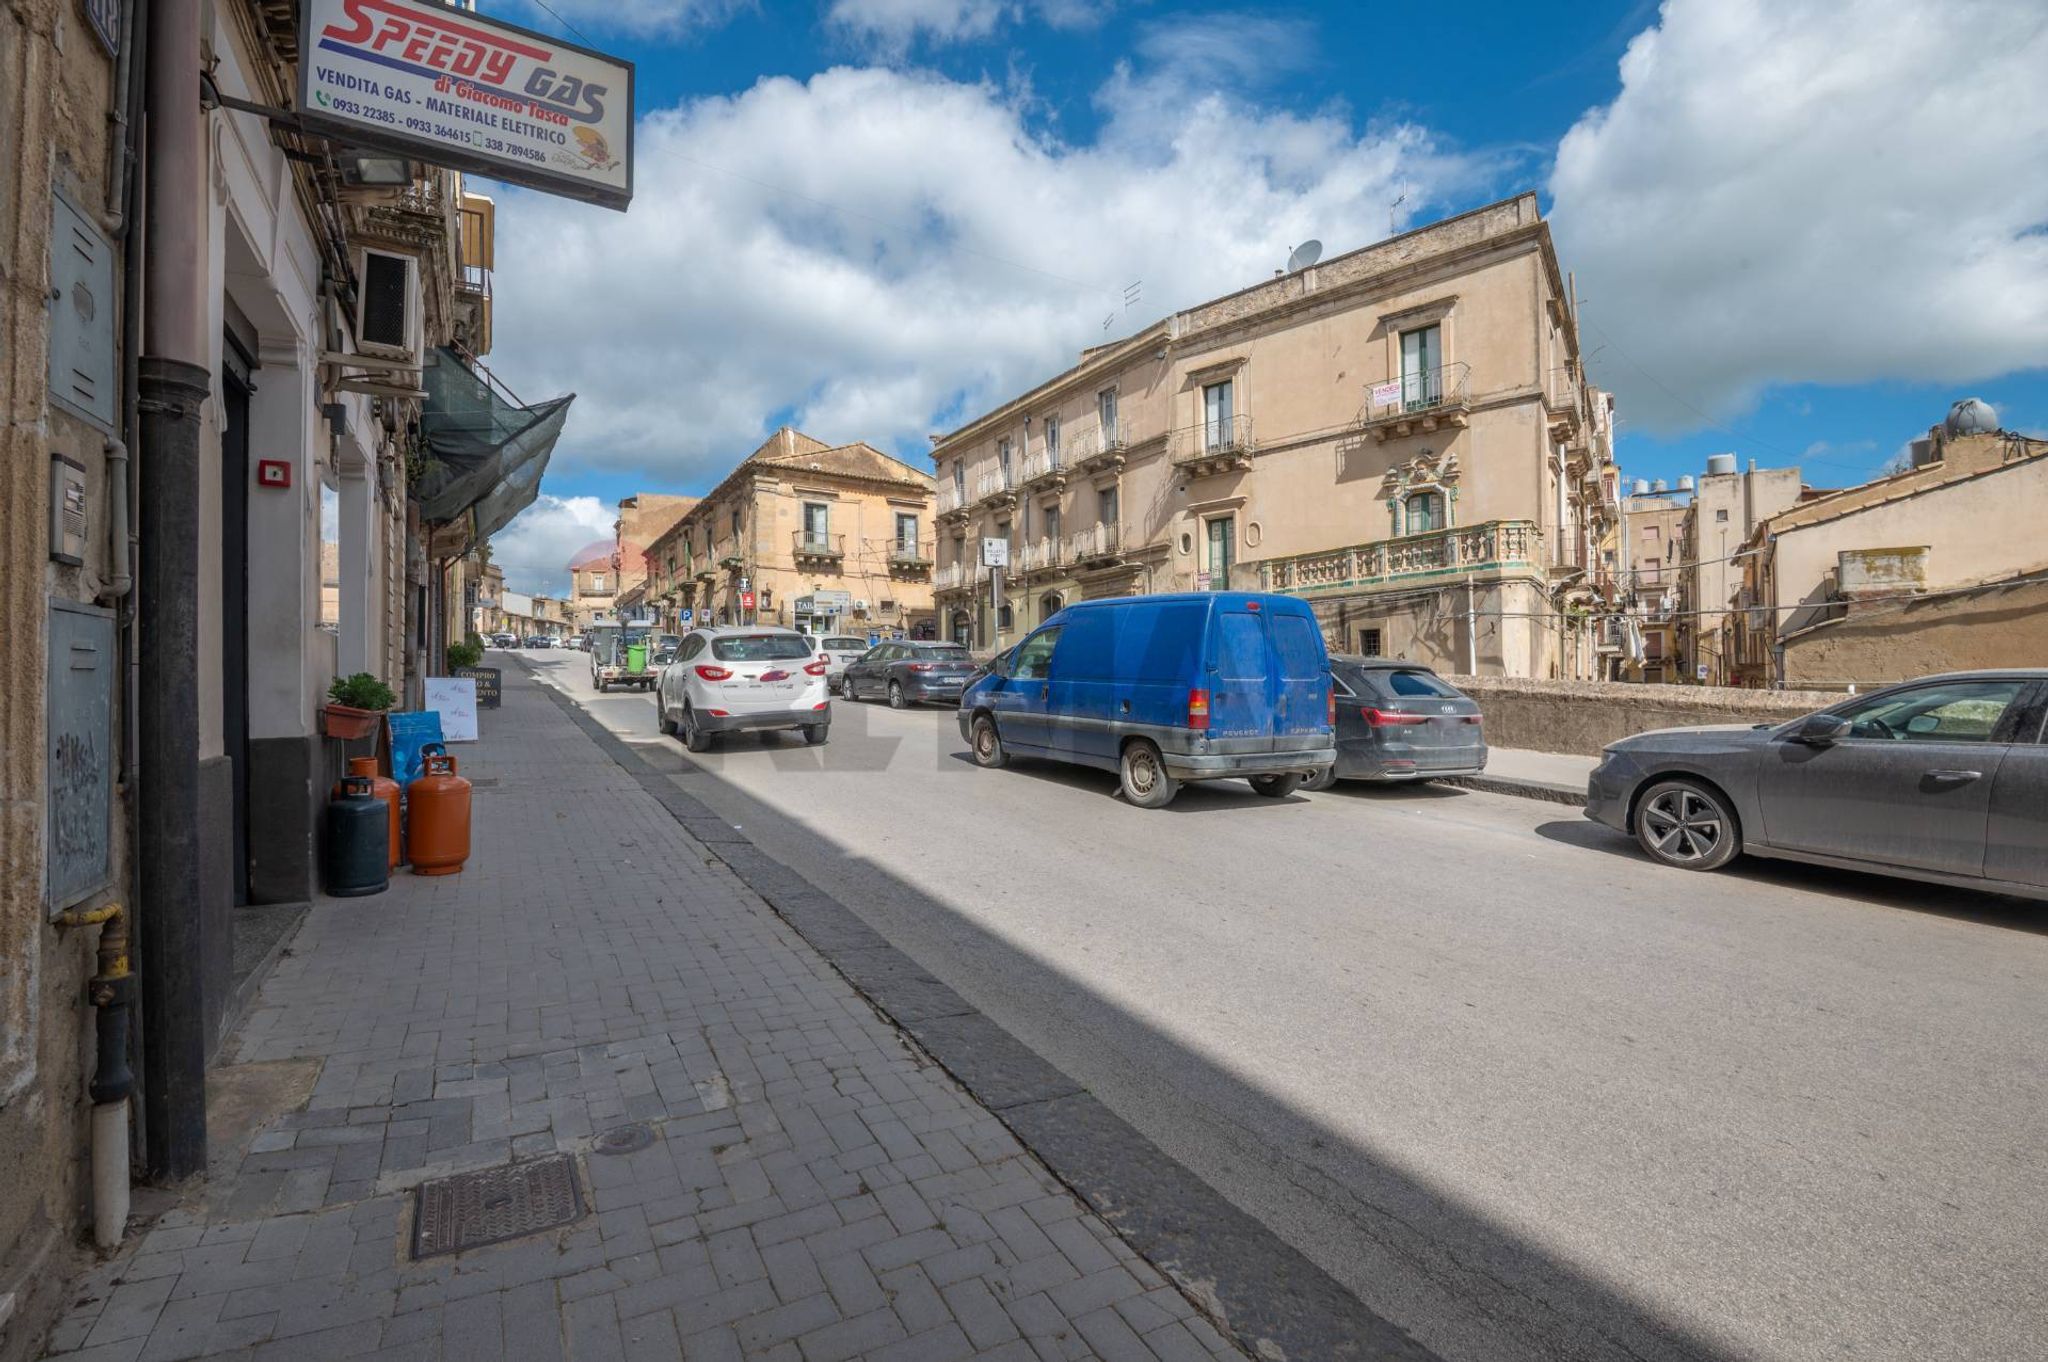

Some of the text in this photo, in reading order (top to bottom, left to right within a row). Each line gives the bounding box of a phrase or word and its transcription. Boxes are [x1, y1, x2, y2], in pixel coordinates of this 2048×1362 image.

[321, 0, 608, 124] SPEEDY GAS
[316, 66, 380, 97] VENDITA
[384, 86, 411, 105] GAS
[426, 98, 498, 128] MATERIALE
[502, 117, 566, 145] ELETTRICO
[333, 98, 360, 114] 0933
[363, 106, 395, 123] 22385
[406, 117, 432, 134] 0933
[434, 124, 471, 143] 364615
[485, 137, 503, 151] 338
[506, 143, 546, 162] 7894586
[434, 74, 569, 127] di Giacomo Tasca
